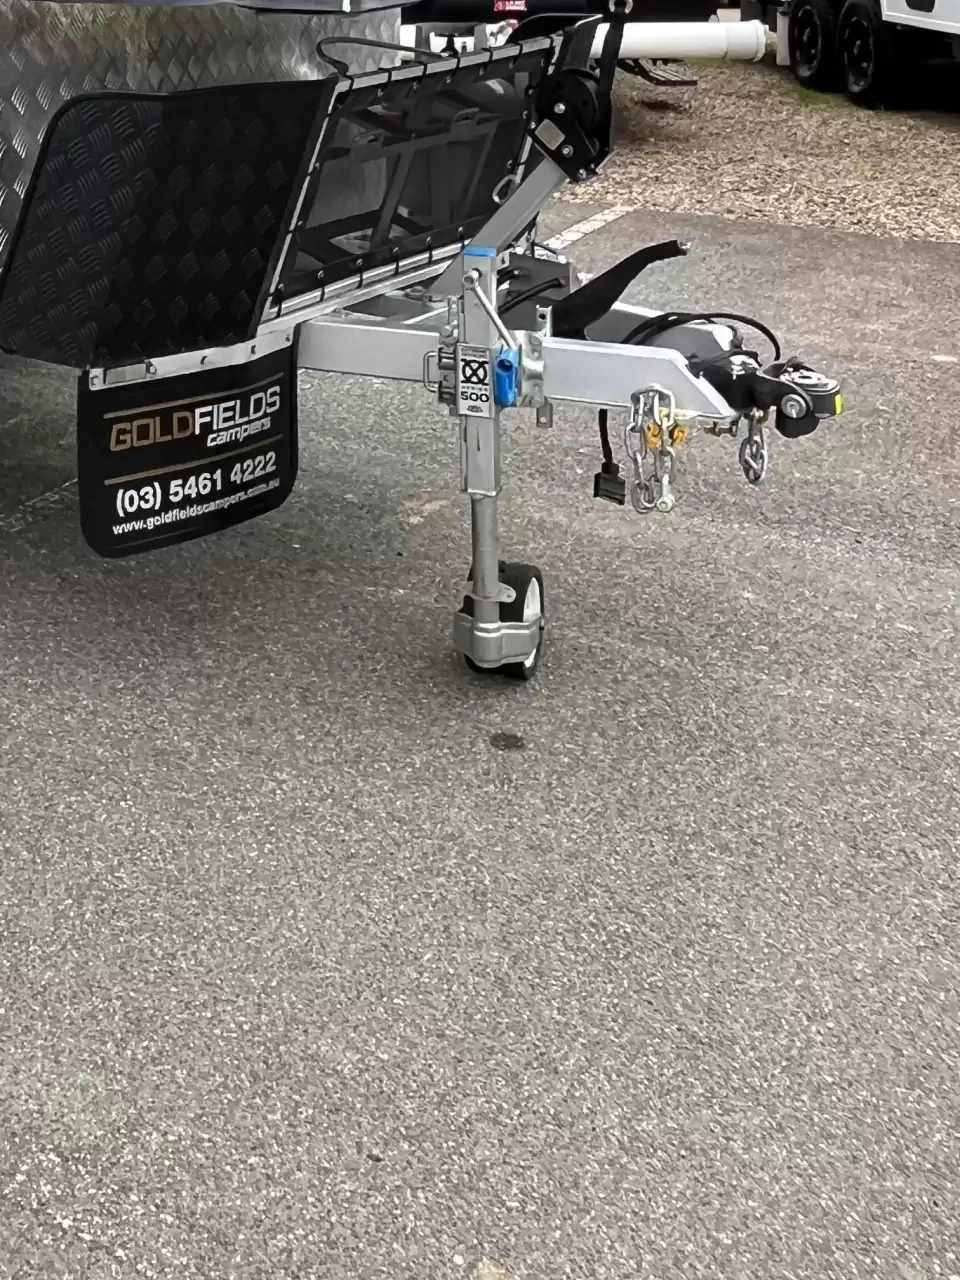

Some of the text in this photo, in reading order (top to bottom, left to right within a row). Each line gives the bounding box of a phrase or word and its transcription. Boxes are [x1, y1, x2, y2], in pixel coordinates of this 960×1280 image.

[110, 385, 280, 452] GOLDFIELDS
[460, 391, 490, 403] 500
[112, 477, 280, 535] www.goldfieldscampers..
[116, 451, 277, 517] (03) 5461 4222
